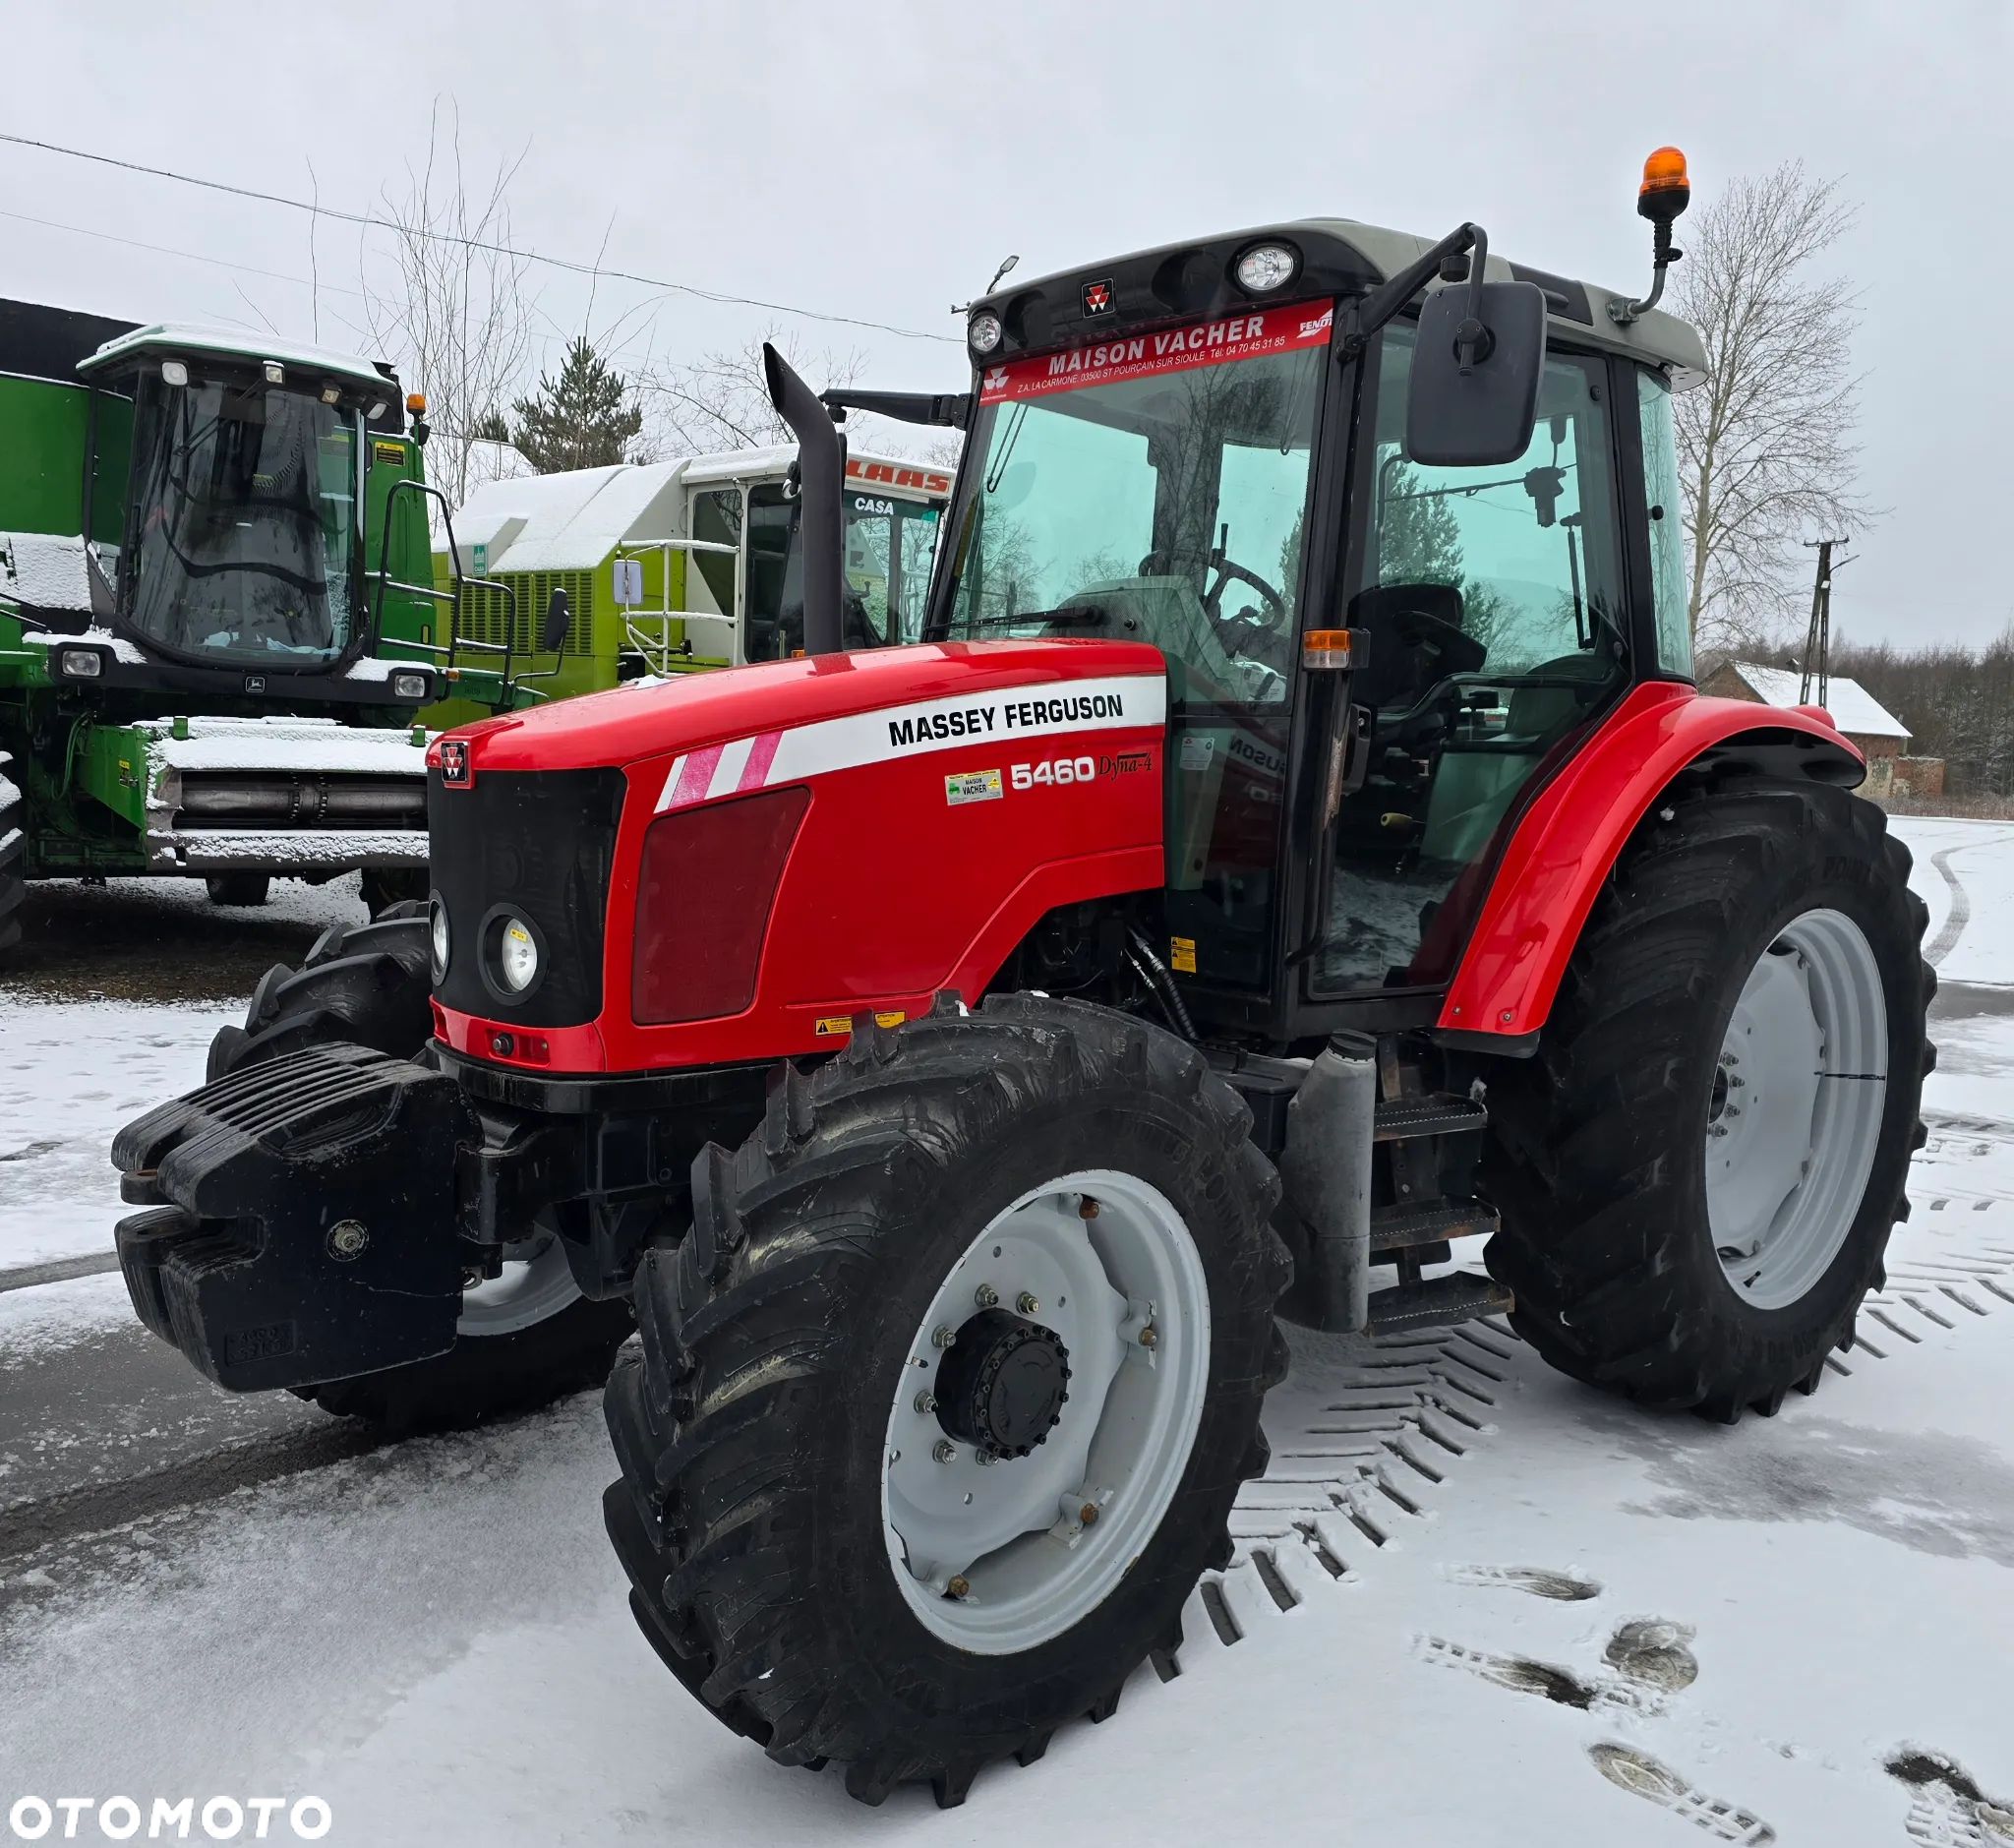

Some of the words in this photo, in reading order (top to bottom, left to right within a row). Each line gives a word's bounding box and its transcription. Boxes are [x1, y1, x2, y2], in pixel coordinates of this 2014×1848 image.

[1032, 382, 1041, 390] LA
[1081, 370, 1101, 383] 03500
[1102, 368, 1114, 378] ST
[1114, 361, 1155, 376] POURÇAIN
[1155, 356, 1173, 368] SUR
[1175, 350, 1206, 365] SIOULE
[1226, 344, 1236, 356] 04
[1238, 342, 1248, 354] 70
[1250, 340, 1260, 351] 45
[1262, 337, 1273, 349] 31
[1274, 335, 1286, 347] 85
[1048, 339, 1145, 376] MAISON
[1155, 316, 1264, 355] VACHER
[846, 458, 950, 493] LAAS
[855, 497, 895, 515] CASA
[888, 706, 995, 747] MASSEY
[1004, 693, 1124, 729] FERGUSON
[962, 784, 987, 796] VACHER
[1010, 756, 1096, 790] 5460
[1098, 750, 1153, 781] Dyna-4
